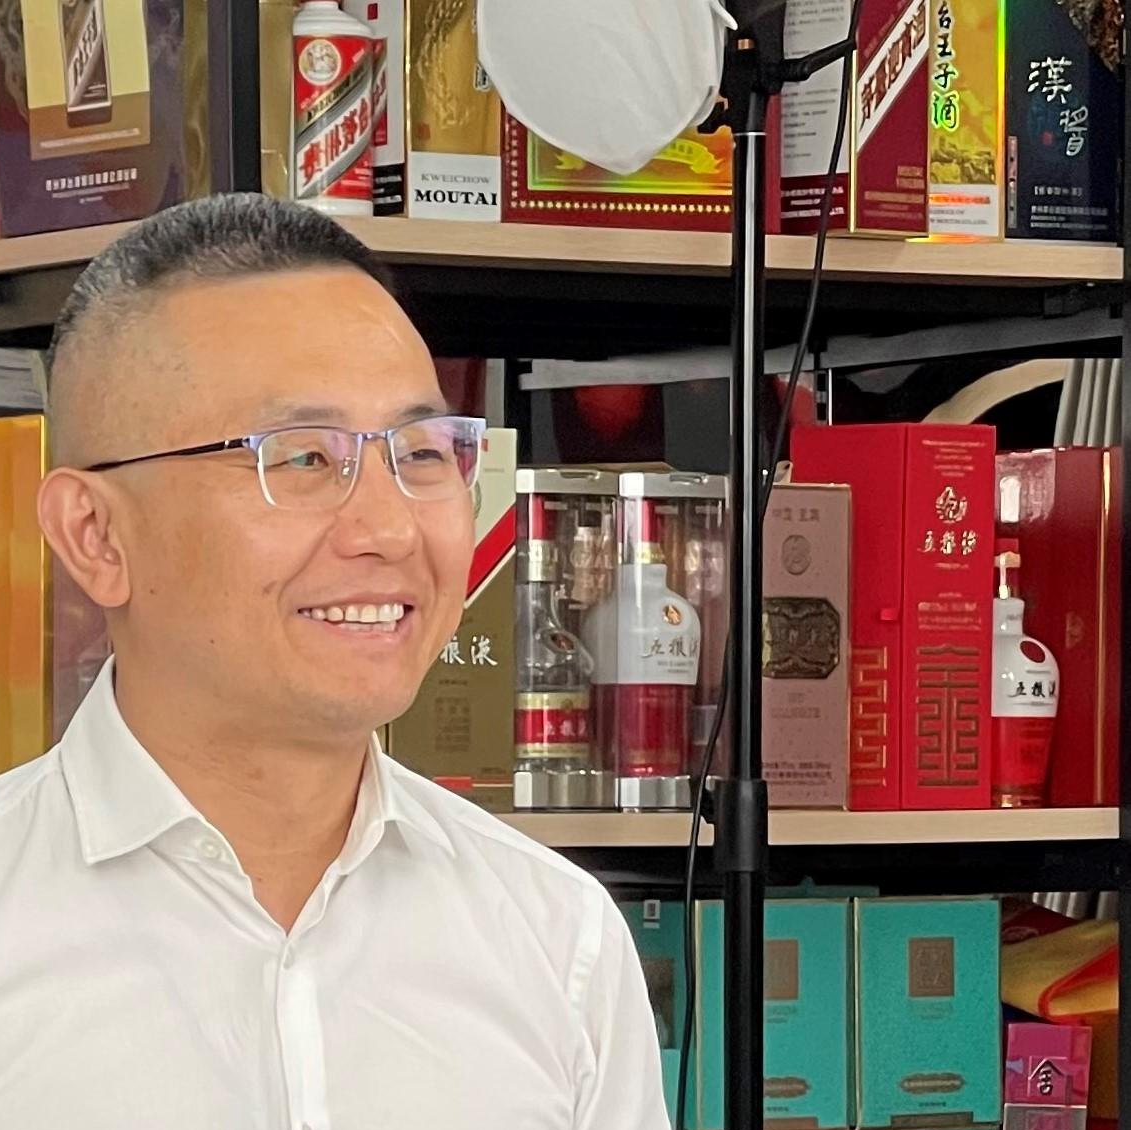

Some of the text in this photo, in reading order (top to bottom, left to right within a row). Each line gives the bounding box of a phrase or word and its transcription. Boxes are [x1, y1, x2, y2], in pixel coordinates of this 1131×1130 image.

[933, 3, 957, 130] 台王子酒
[421, 172, 492, 185] KWEICHOW
[414, 188, 498, 206] MOUTAI
